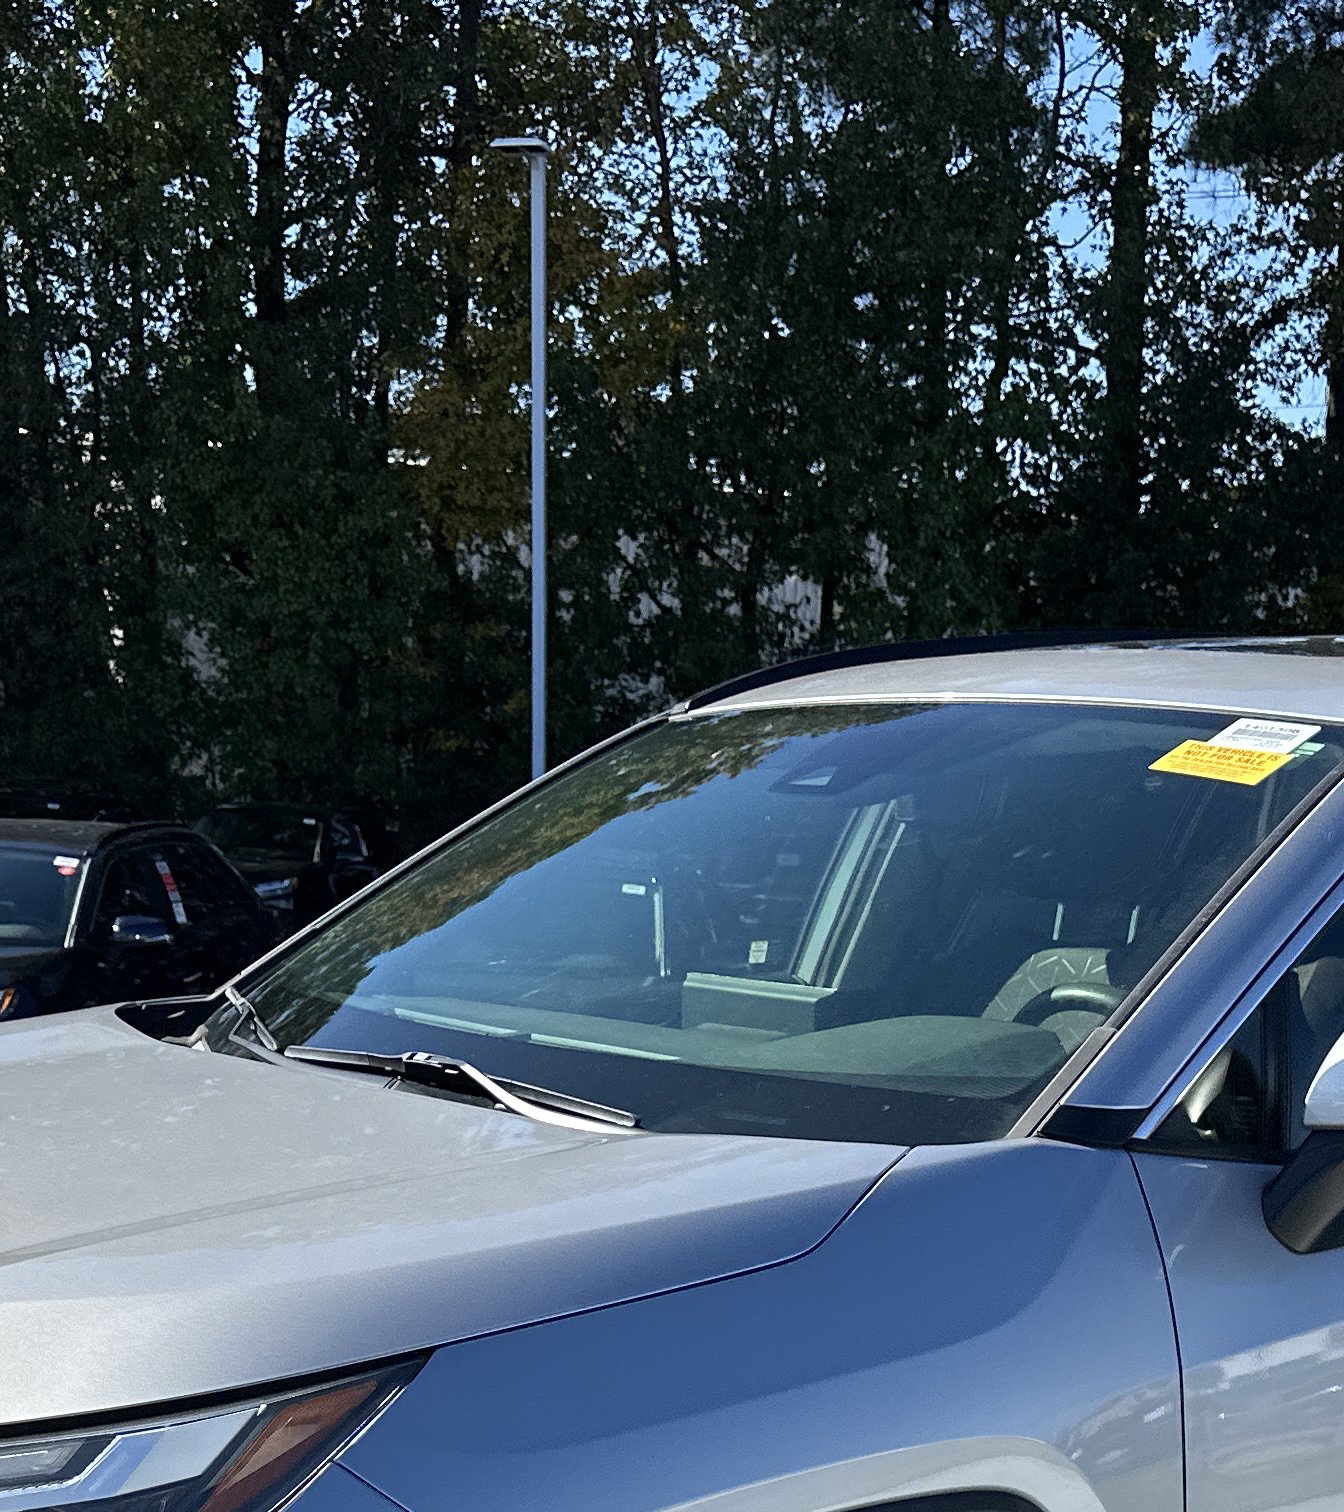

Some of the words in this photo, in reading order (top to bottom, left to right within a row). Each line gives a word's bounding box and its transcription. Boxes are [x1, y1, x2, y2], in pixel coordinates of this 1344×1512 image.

[1183, 749, 1208, 758] NOT
[1209, 752, 1234, 761] FOR
[1236, 756, 1267, 767] SALE
[1188, 743, 1216, 752] THIS
[1217, 746, 1263, 758] VEHICLE
[1266, 754, 1282, 762] IS
